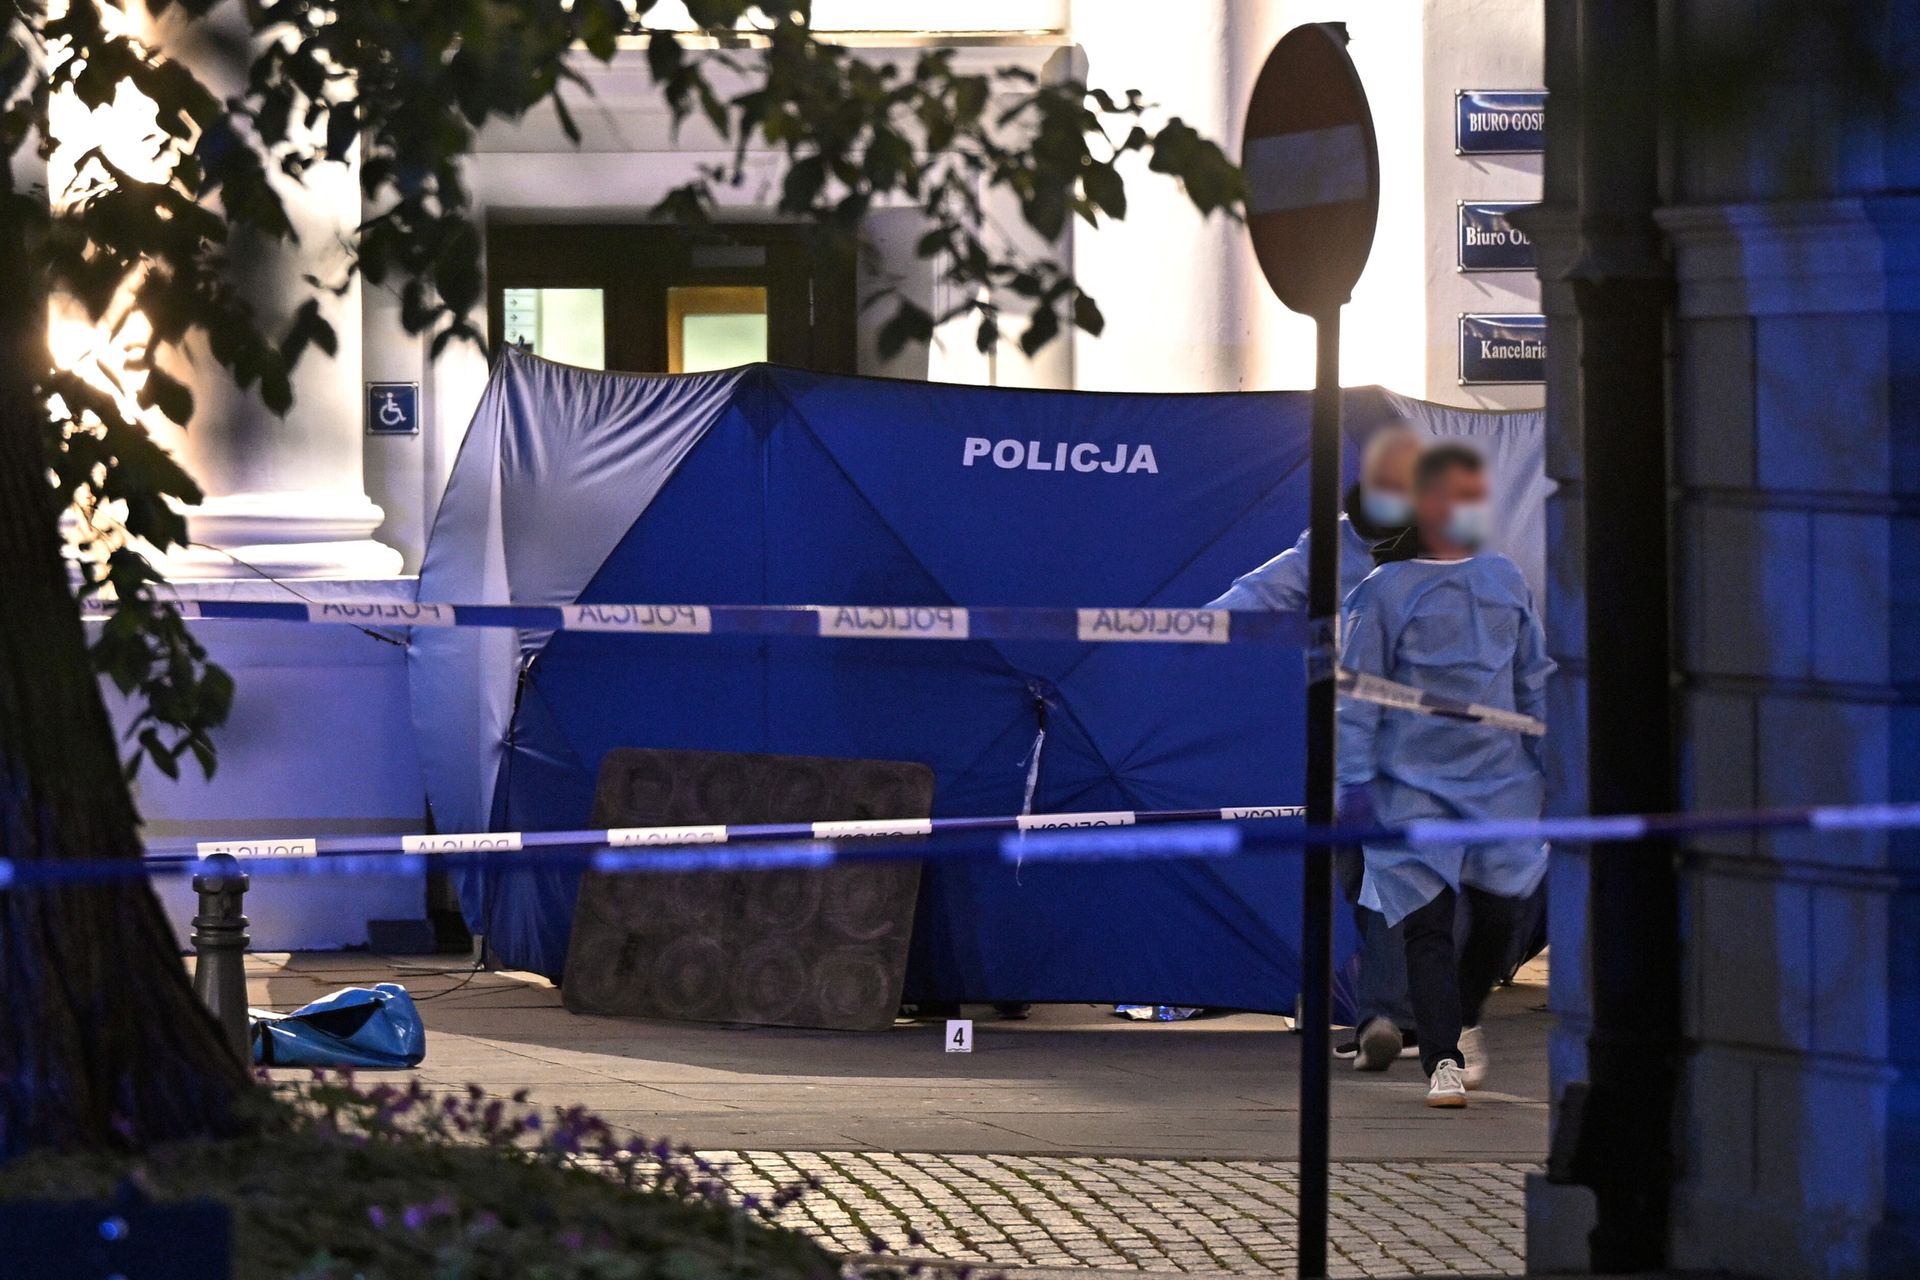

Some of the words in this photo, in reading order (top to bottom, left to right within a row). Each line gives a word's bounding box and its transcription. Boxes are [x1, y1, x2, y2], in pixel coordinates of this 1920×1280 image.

[1469, 113, 1509, 132] BIURO
[1466, 227, 1506, 246] Biuro
[1481, 340, 1548, 359] Kancelaria
[962, 437, 1159, 474] POLICJA
[953, 1027, 965, 1047] 4
